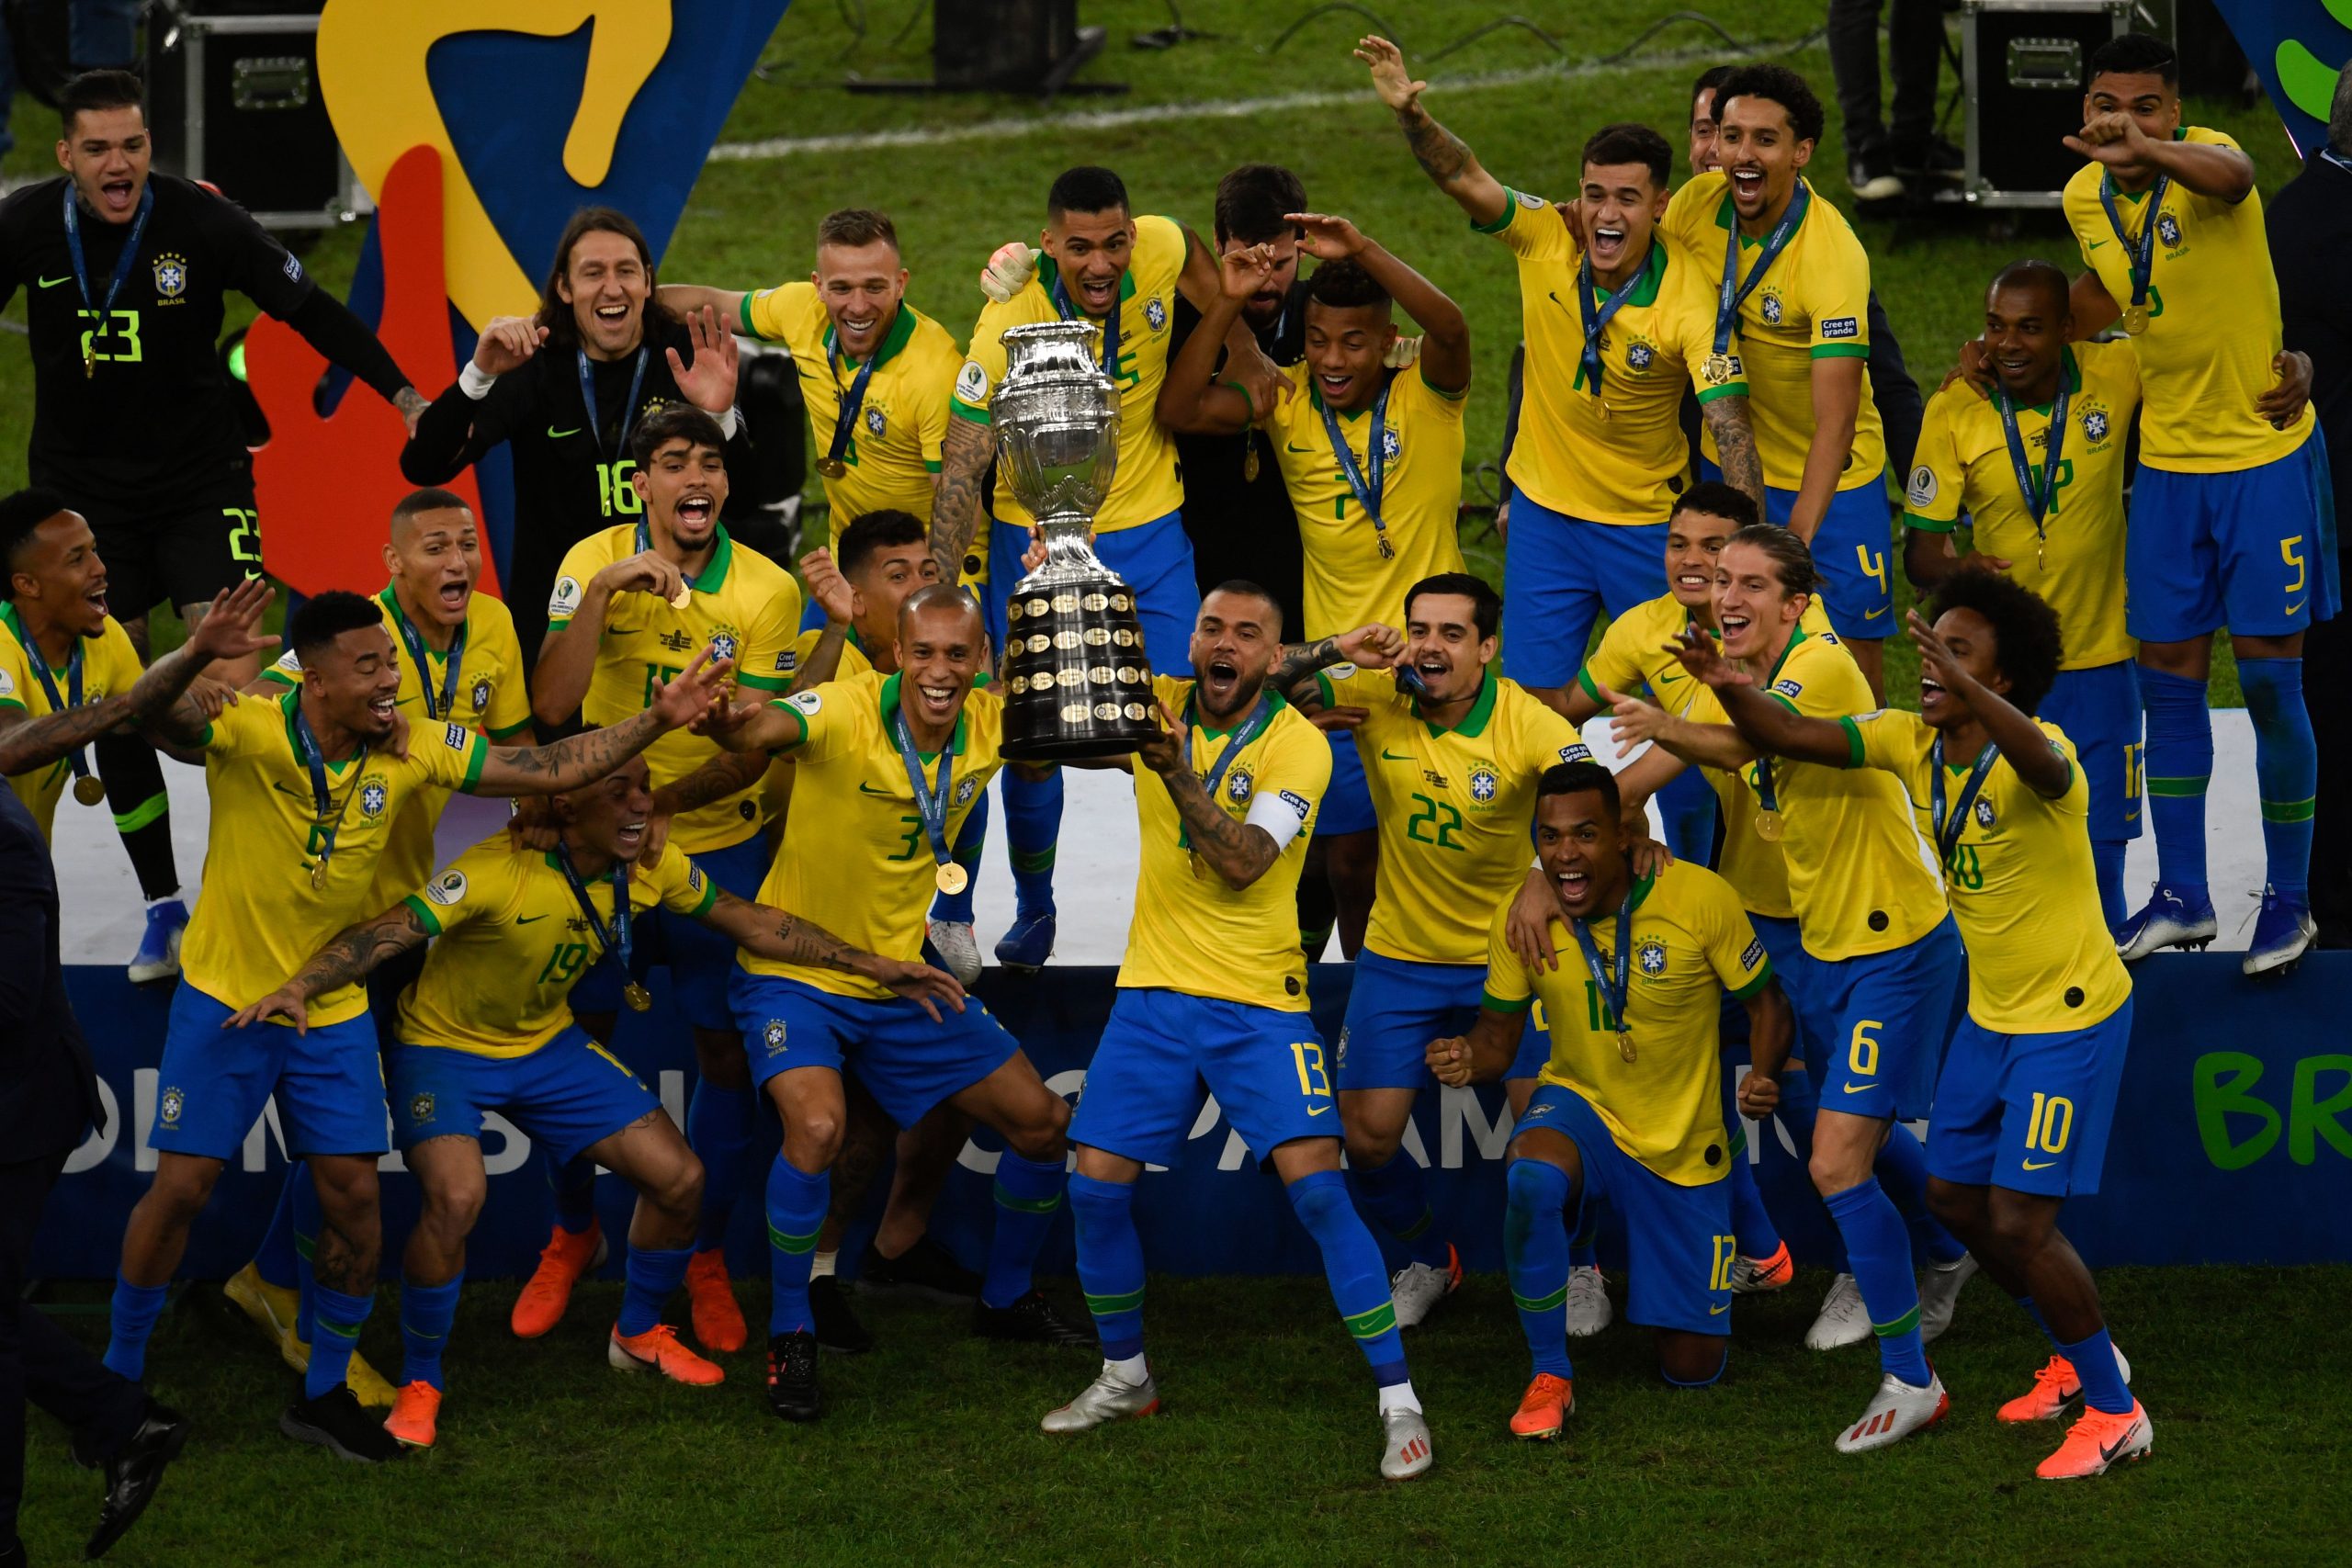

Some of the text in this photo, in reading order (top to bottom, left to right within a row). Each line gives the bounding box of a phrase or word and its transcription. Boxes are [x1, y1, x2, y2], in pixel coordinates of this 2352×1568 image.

[2165, 247, 2191, 262] BRASIL
[77, 310, 142, 362] 23
[1824, 327, 1854, 338] grande
[2086, 443, 2113, 456] BRASIL
[595, 459, 644, 517] 16
[1856, 544, 1886, 595] 4
[2279, 535, 2304, 603] 5
[1561, 749, 1577, 757] Cree
[1565, 751, 1590, 764] grande
[1281, 793, 1308, 812] Cree en
[1408, 792, 1464, 851] 22
[887, 816, 924, 861] 3
[537, 942, 589, 985] 19
[1745, 946, 1762, 970] grande
[1289, 1042, 1331, 1098] 13
[1849, 1019, 1883, 1076] 6
[2025, 1091, 2075, 1154] 10
[1709, 1235, 1736, 1291] 12
